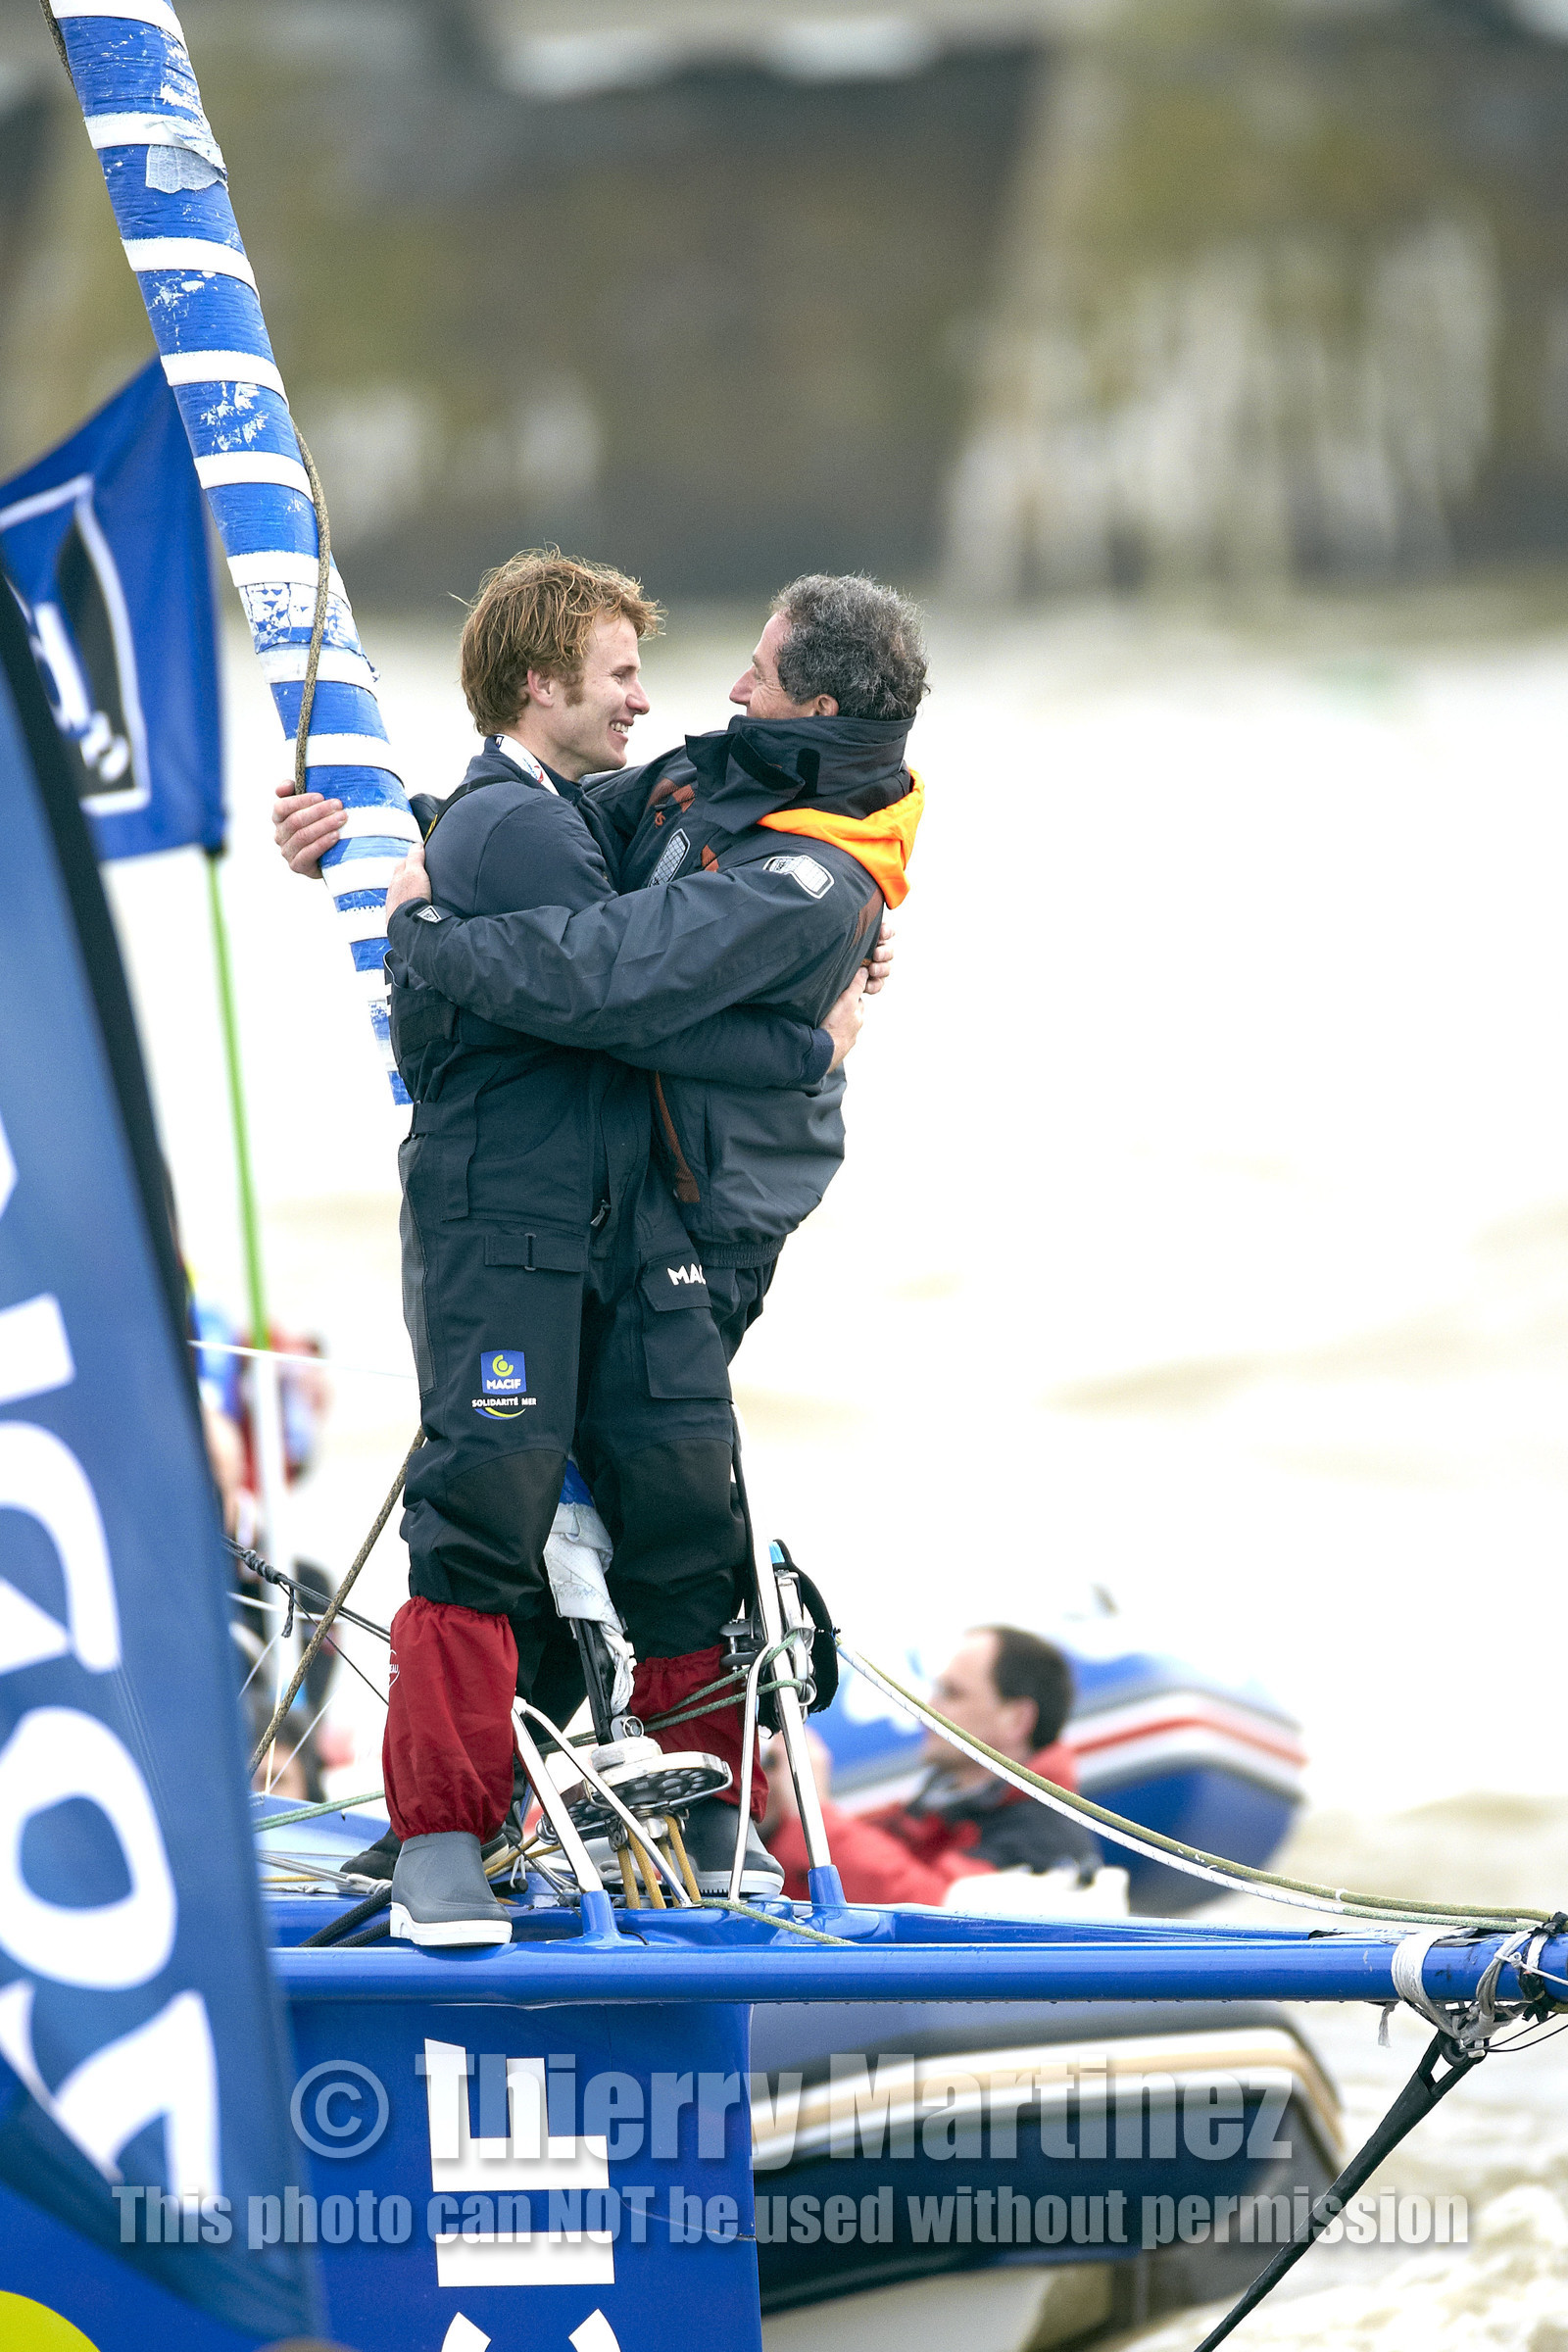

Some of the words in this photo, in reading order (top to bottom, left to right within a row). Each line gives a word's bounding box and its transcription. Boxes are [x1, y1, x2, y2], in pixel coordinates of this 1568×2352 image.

[486, 1378, 522, 1390] MACIF
[471, 1396, 519, 1408] SOLIDARITÉ
[521, 1397, 537, 1406] MER
[424, 2037, 622, 2352] IF
